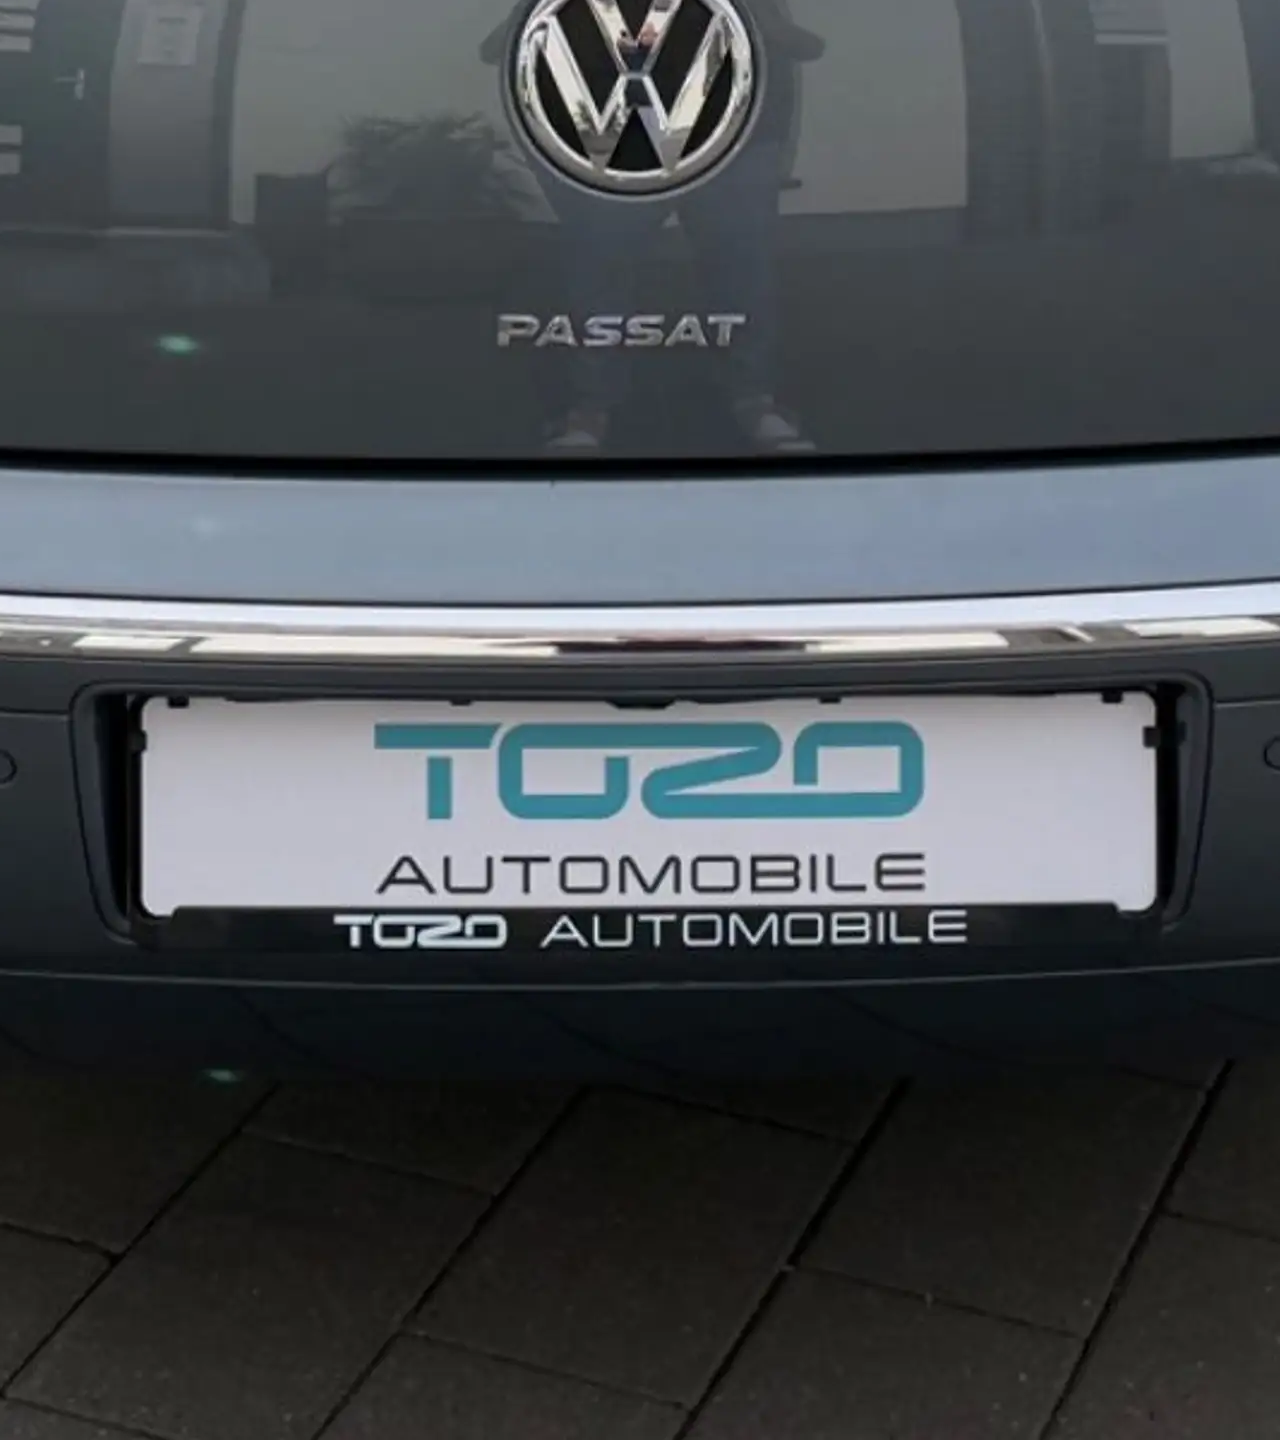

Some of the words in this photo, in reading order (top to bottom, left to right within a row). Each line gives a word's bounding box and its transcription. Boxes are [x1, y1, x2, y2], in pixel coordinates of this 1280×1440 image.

[496, 312, 748, 348] PASSAT
[374, 721, 925, 821] TOZO
[376, 851, 927, 896] AUTOMOBILE
[332, 913, 508, 949] TOZO
[539, 908, 969, 948] AUTOMOBILE
